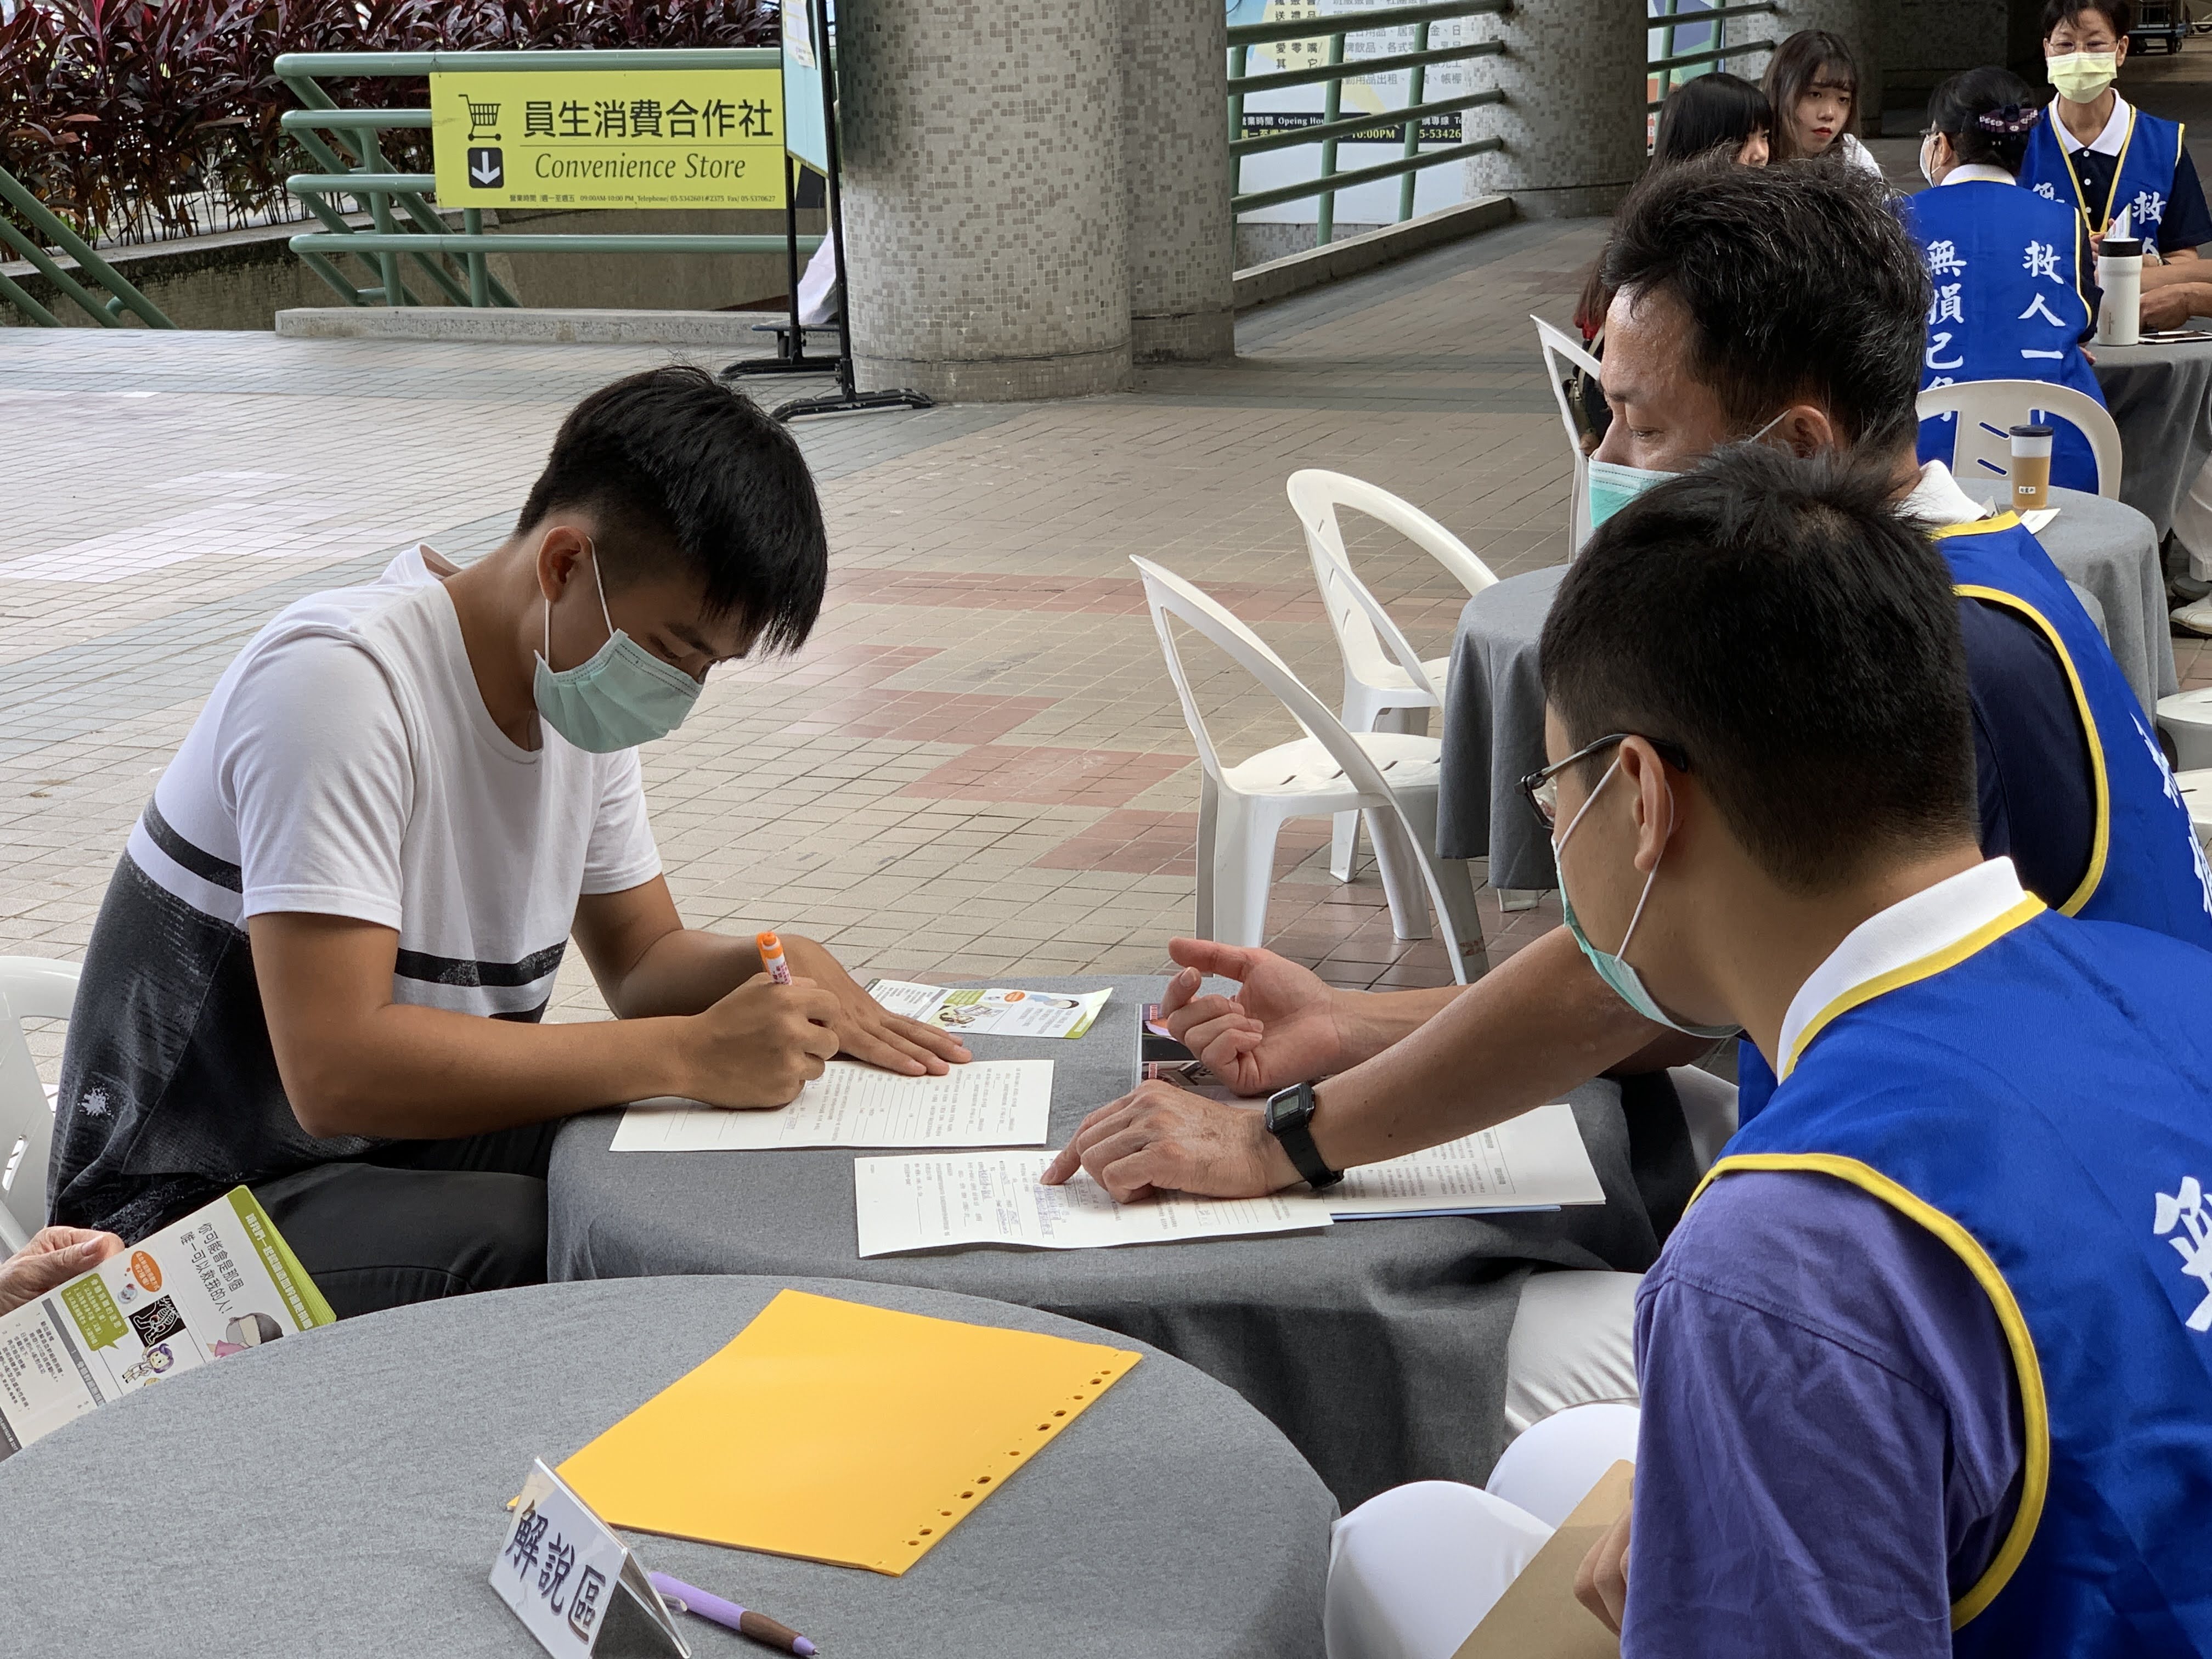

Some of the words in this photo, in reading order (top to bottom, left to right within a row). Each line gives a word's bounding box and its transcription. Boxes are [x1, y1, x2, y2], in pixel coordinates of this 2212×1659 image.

[523, 99, 774, 138] 員生消費合作社
[1278, 116, 1307, 126] Opeing
[535, 153, 676, 178] Convenience
[685, 153, 746, 178] Store
[2018, 240, 2066, 424] 救人一
[180, 1232, 233, 1314] 唯一可以救我的人!
[197, 1222, 244, 1292] 你可能會是那個
[505, 1500, 606, 1645] 解說區
